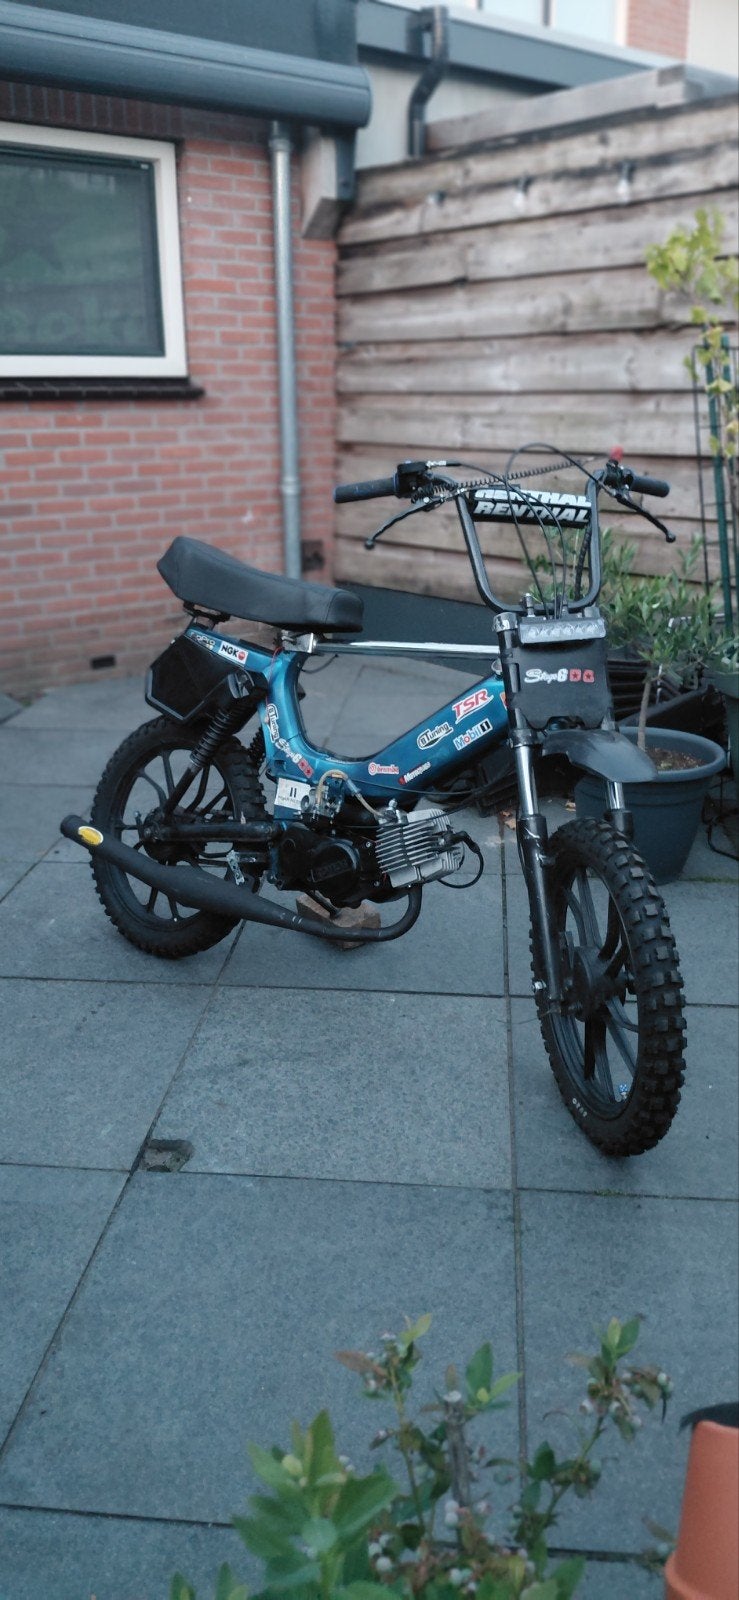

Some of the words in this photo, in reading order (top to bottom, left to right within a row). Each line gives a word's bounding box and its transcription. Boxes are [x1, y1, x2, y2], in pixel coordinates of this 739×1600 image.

[473, 501, 589, 523] RENTHAL
[221, 644, 238, 658] NGK
[452, 689, 489, 719] TSR
[455, 726, 481, 749] Mobil
[481, 720, 491, 733] 1
